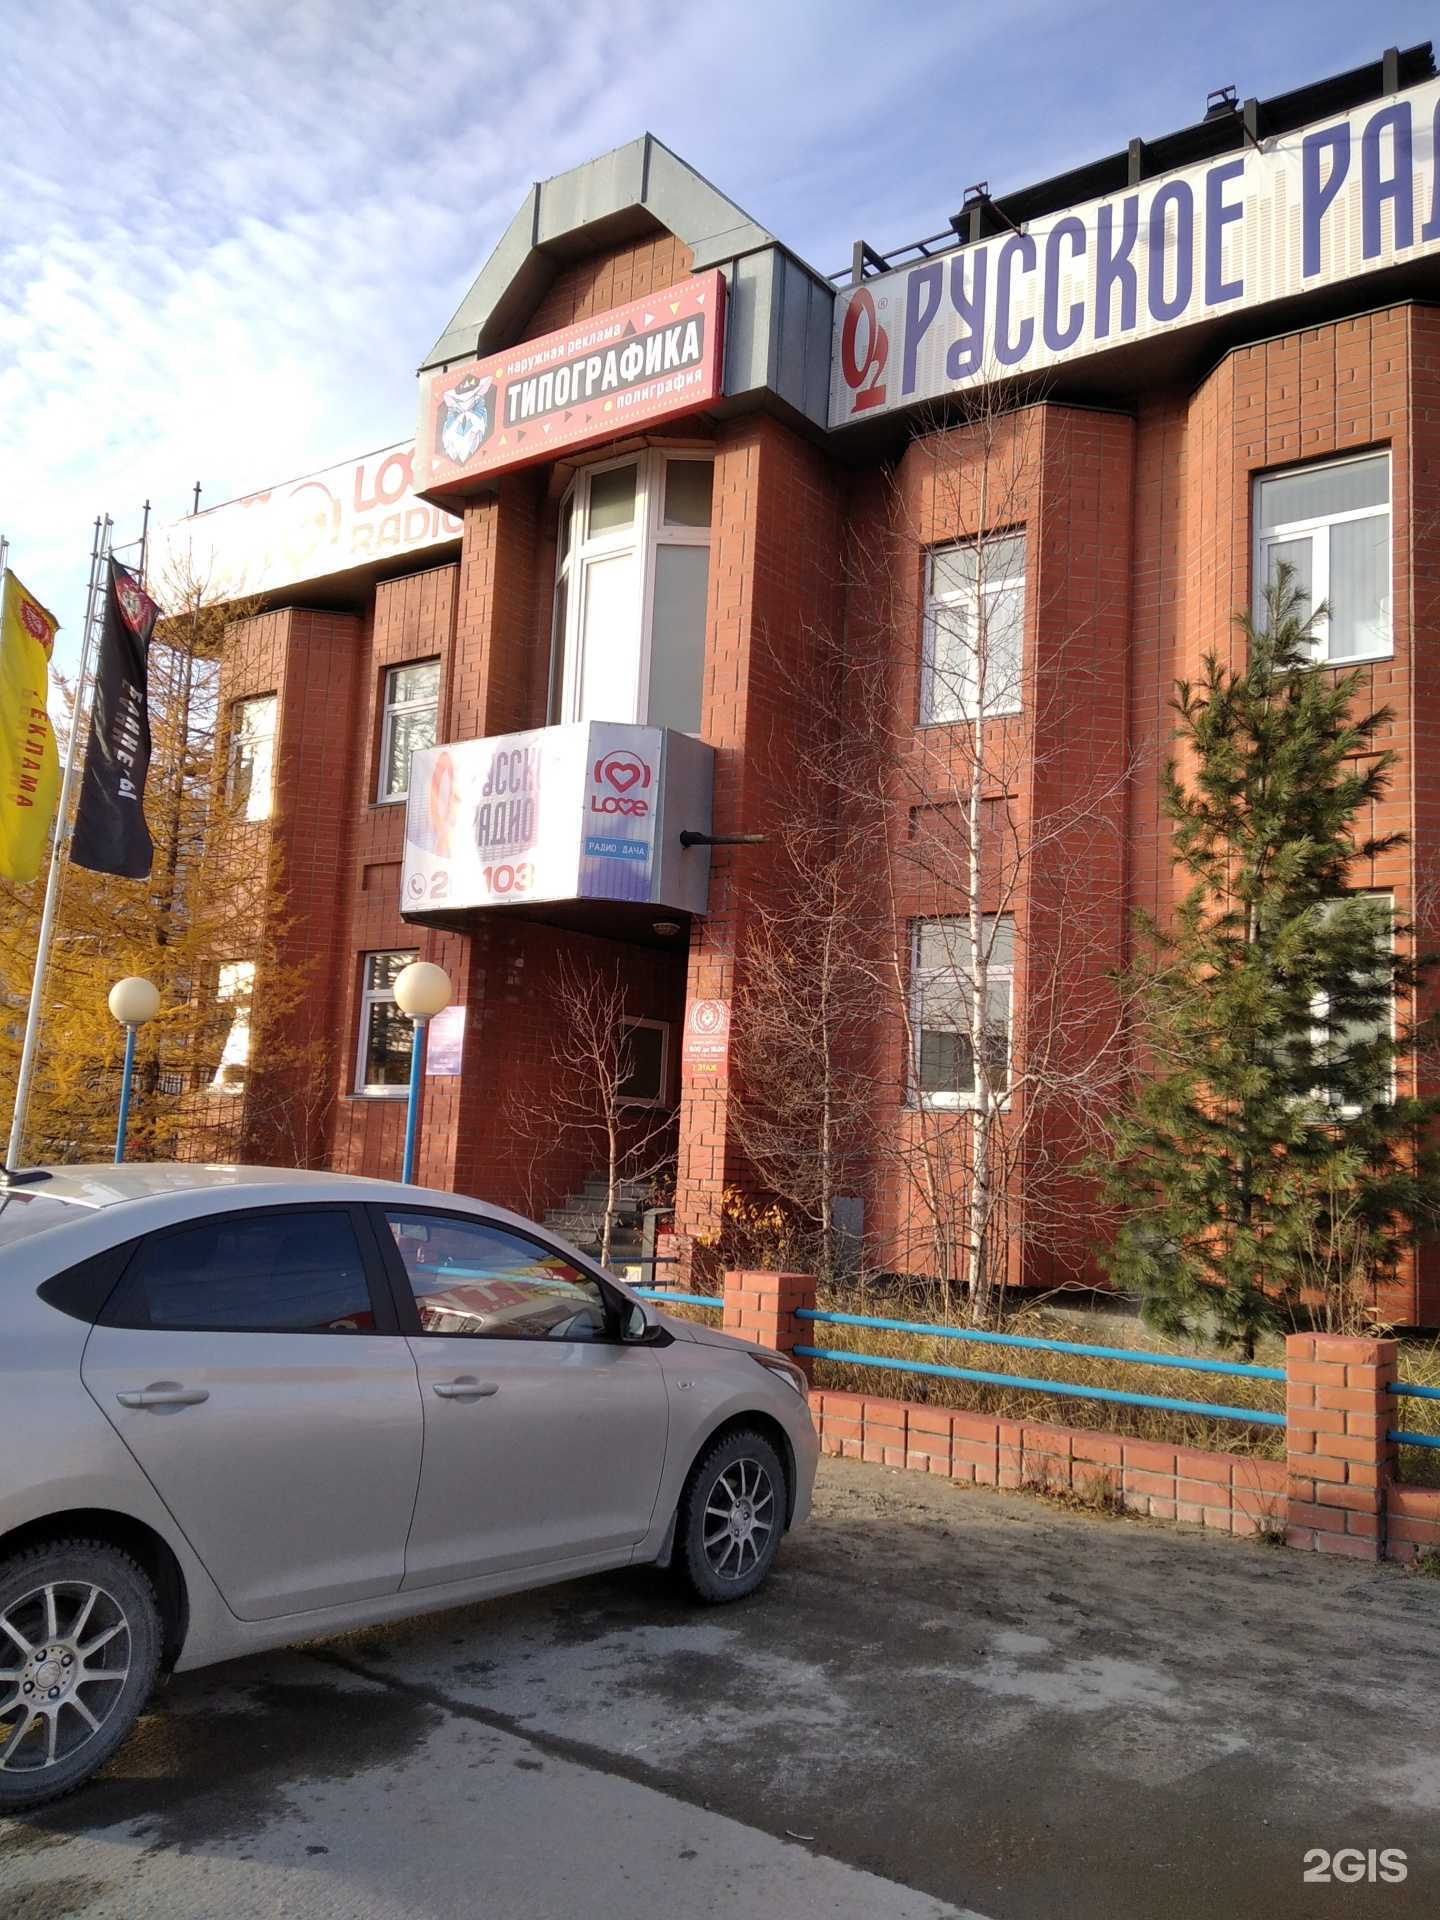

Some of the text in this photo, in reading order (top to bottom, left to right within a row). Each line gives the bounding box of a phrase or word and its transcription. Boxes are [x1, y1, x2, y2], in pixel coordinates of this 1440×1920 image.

[901, 158, 1245, 396] РУССКОЕ
[507, 323, 622, 376] наружная реклама
[508, 319, 699, 422] ТИПОГРАФИКА
[616, 368, 703, 409] полиграфия
[473, 798, 535, 848] АДИО
[589, 842, 645, 856] РАДИО ДАЧА
